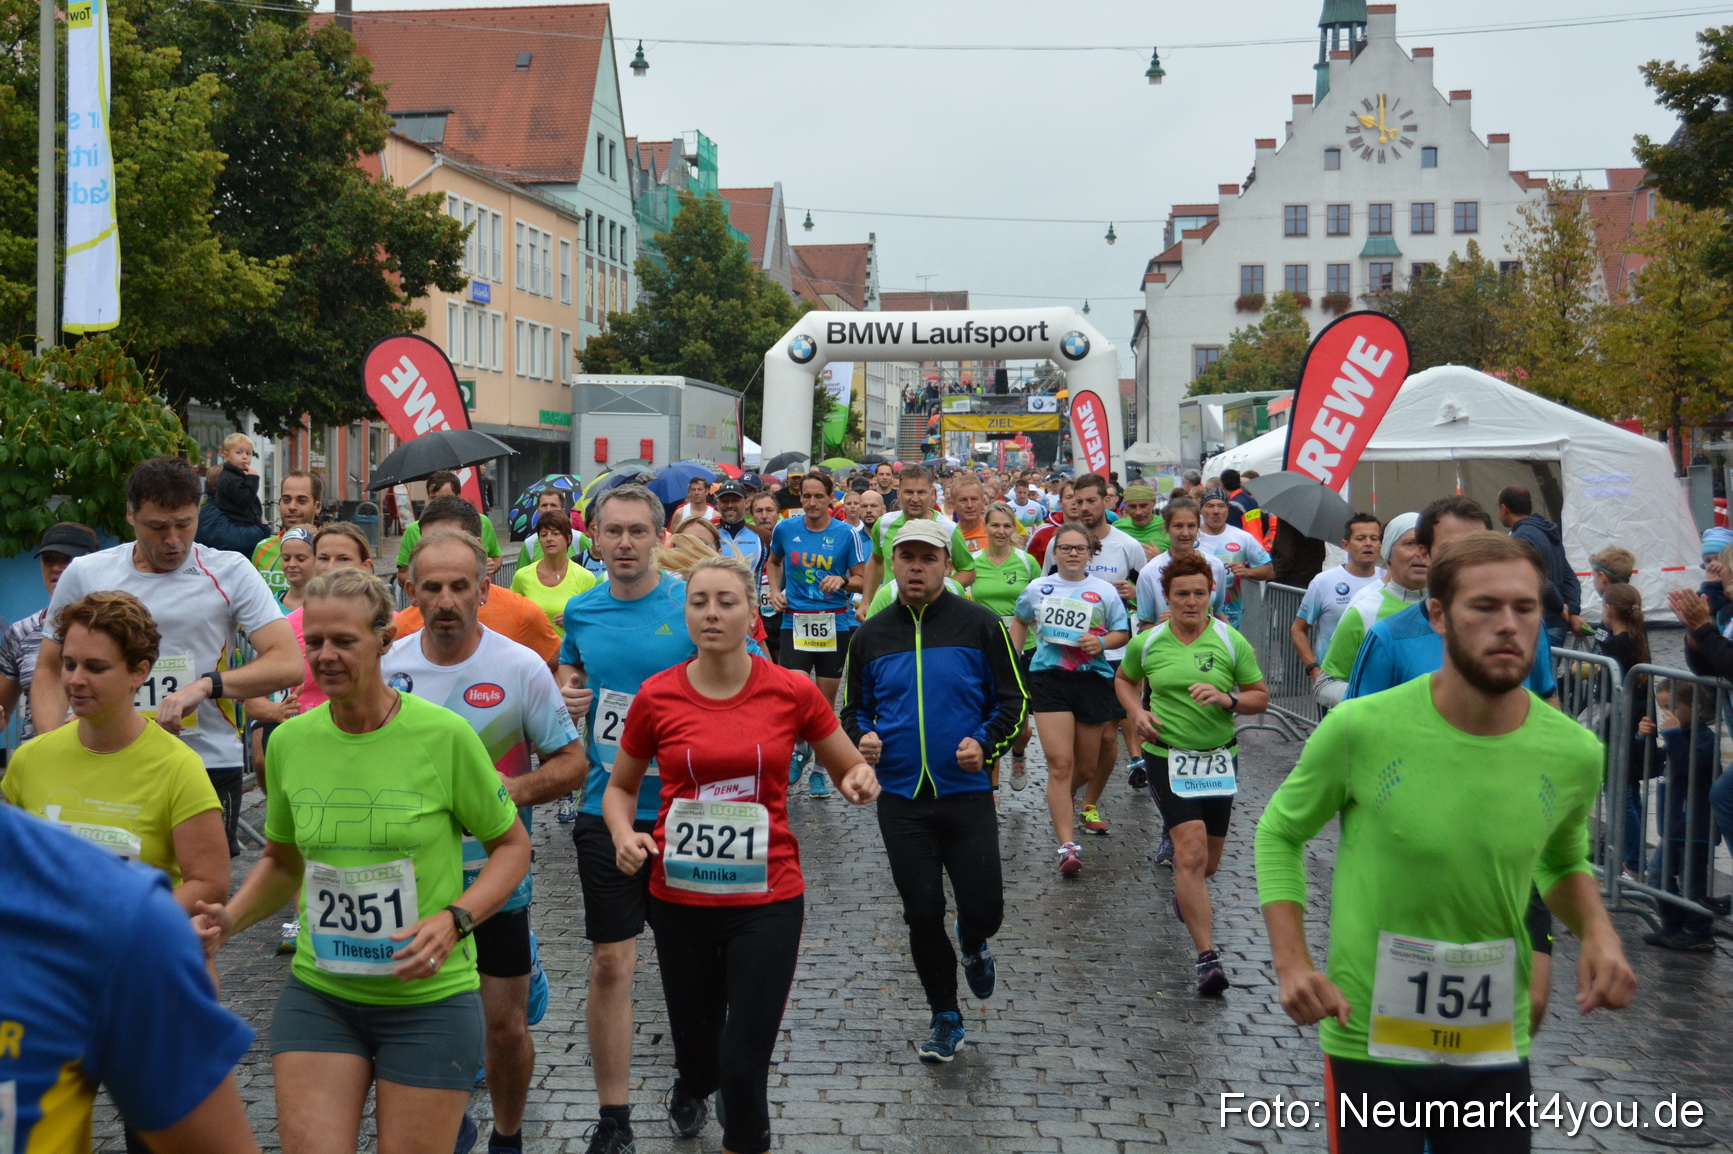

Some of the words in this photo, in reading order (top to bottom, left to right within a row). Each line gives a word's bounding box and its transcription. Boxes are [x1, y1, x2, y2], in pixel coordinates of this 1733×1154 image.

[827, 322, 904, 344] BMW
[912, 320, 1049, 348] Laufsport
[1296, 335, 1393, 485] REWE
[987, 418, 1014, 428] ZIEL
[790, 551, 833, 570] RUN
[1044, 607, 1087, 630] 2682
[802, 623, 828, 637] 165
[1053, 629, 1070, 639] Lena
[134, 676, 178, 706] 13
[469, 689, 500, 702] Hervis
[1175, 755, 1228, 776] 2773
[713, 784, 739, 796] DEHN
[1184, 779, 1223, 790] Christine
[710, 804, 760, 818] BOCK
[676, 822, 755, 860] 2521
[344, 864, 404, 885] BOCK
[692, 867, 737, 881] Annika
[318, 888, 404, 934] 2351
[332, 940, 395, 960] Theresia
[1407, 970, 1492, 1019] 154
[1430, 1029, 1461, 1049] Till
